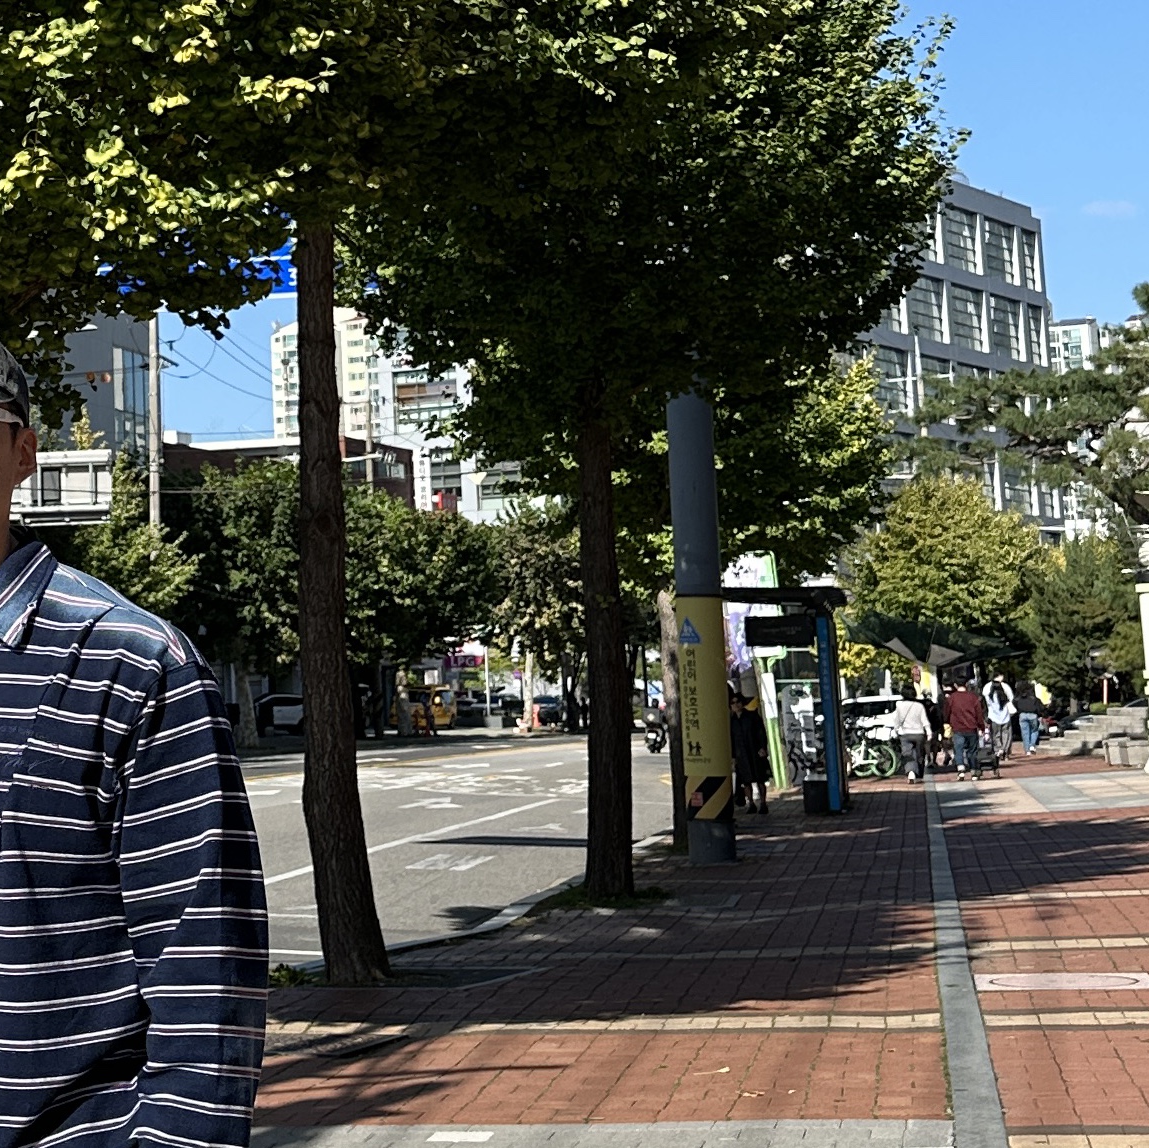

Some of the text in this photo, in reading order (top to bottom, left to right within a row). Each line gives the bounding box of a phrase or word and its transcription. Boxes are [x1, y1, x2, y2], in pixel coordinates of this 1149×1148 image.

[451, 656, 475, 667] LPG
[686, 648, 697, 681] 어린이
[689, 686, 700, 730] 보호구역
